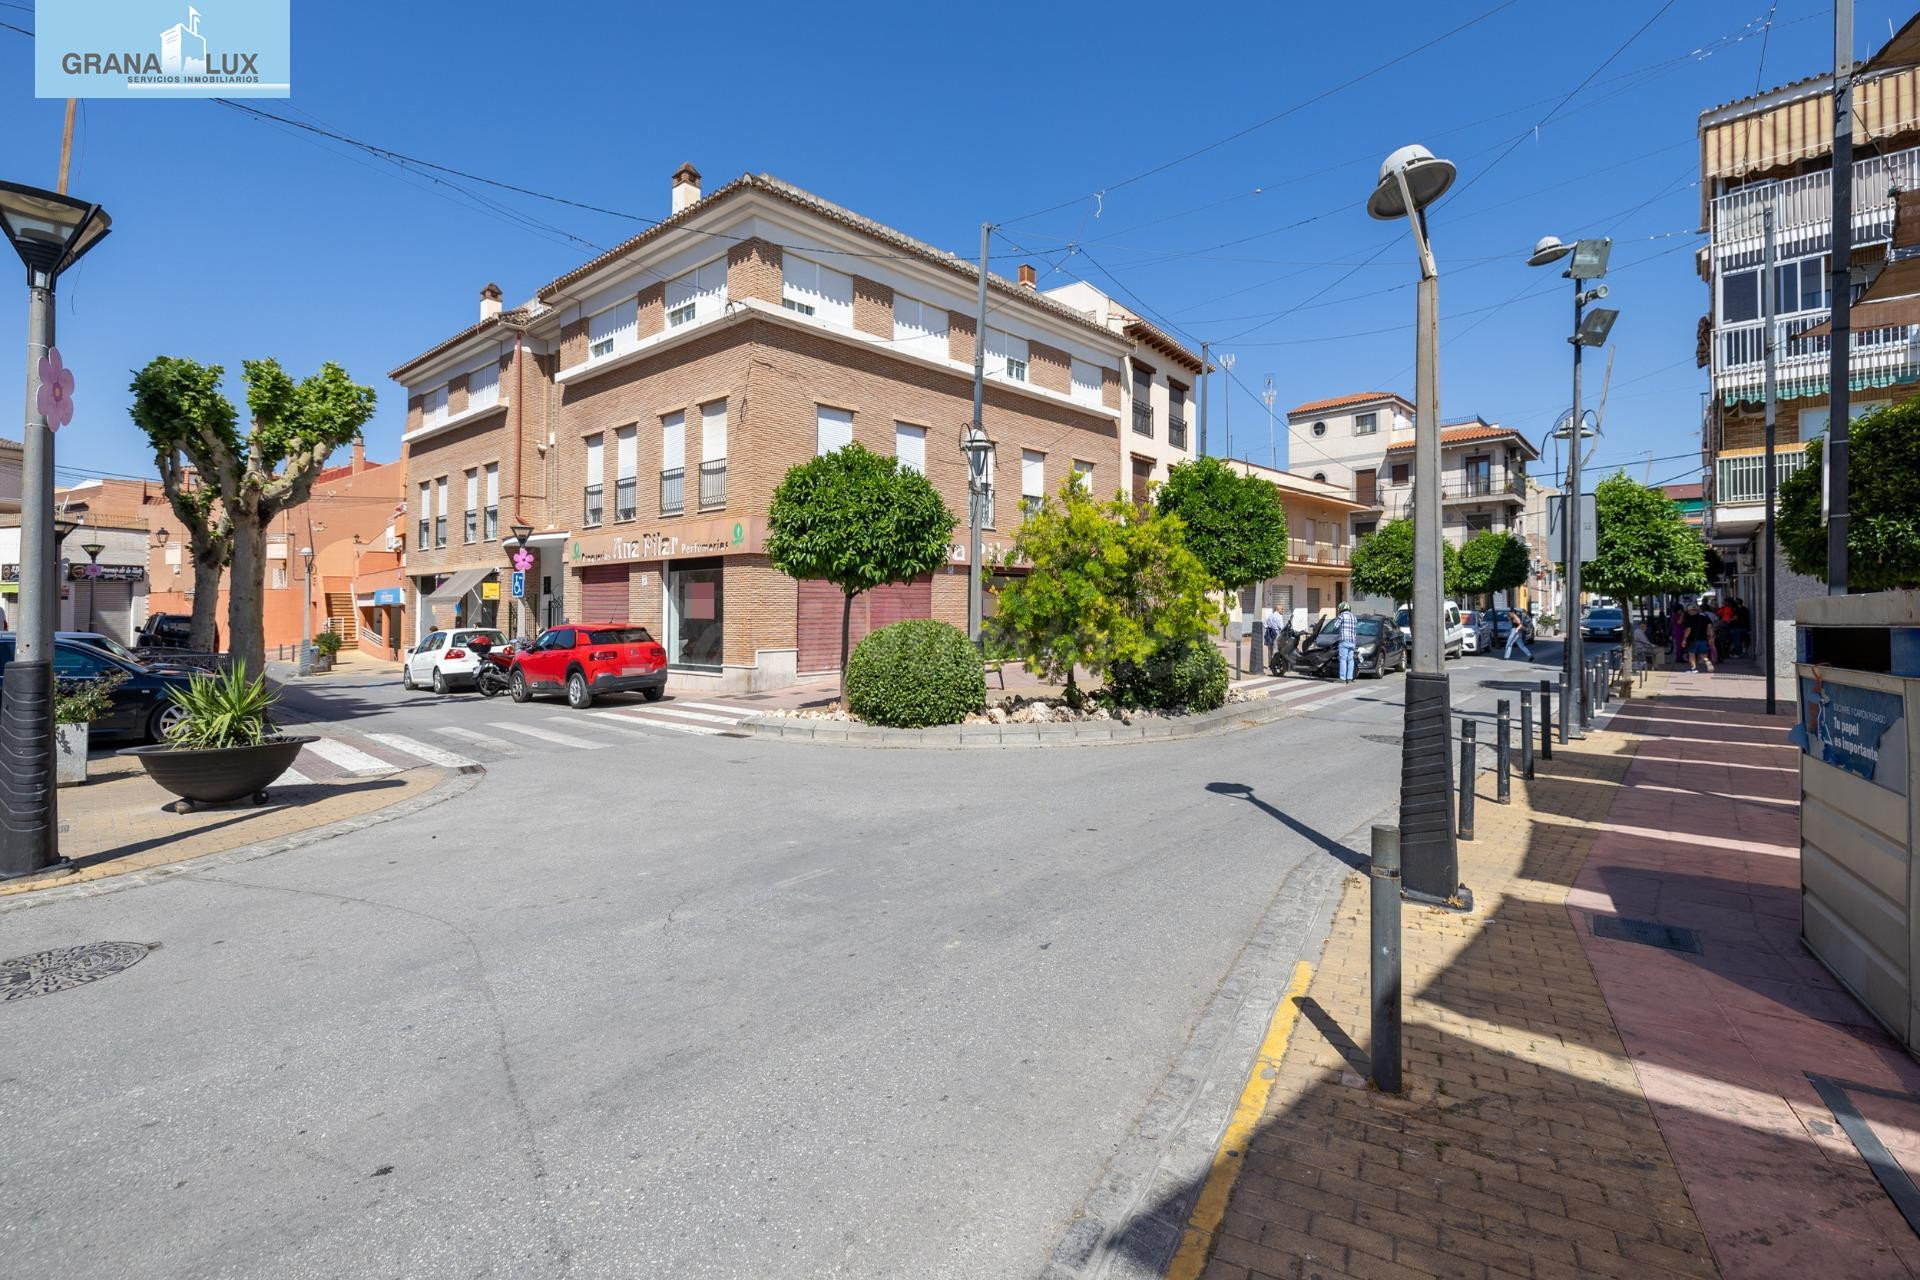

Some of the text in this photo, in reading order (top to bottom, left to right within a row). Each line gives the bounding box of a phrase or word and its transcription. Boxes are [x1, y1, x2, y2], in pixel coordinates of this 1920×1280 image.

[613, 537, 639, 559] Ana
[643, 532, 679, 558] Pilar
[1833, 716, 1859, 736] Tu papel
[1834, 736, 1879, 761] es importante
